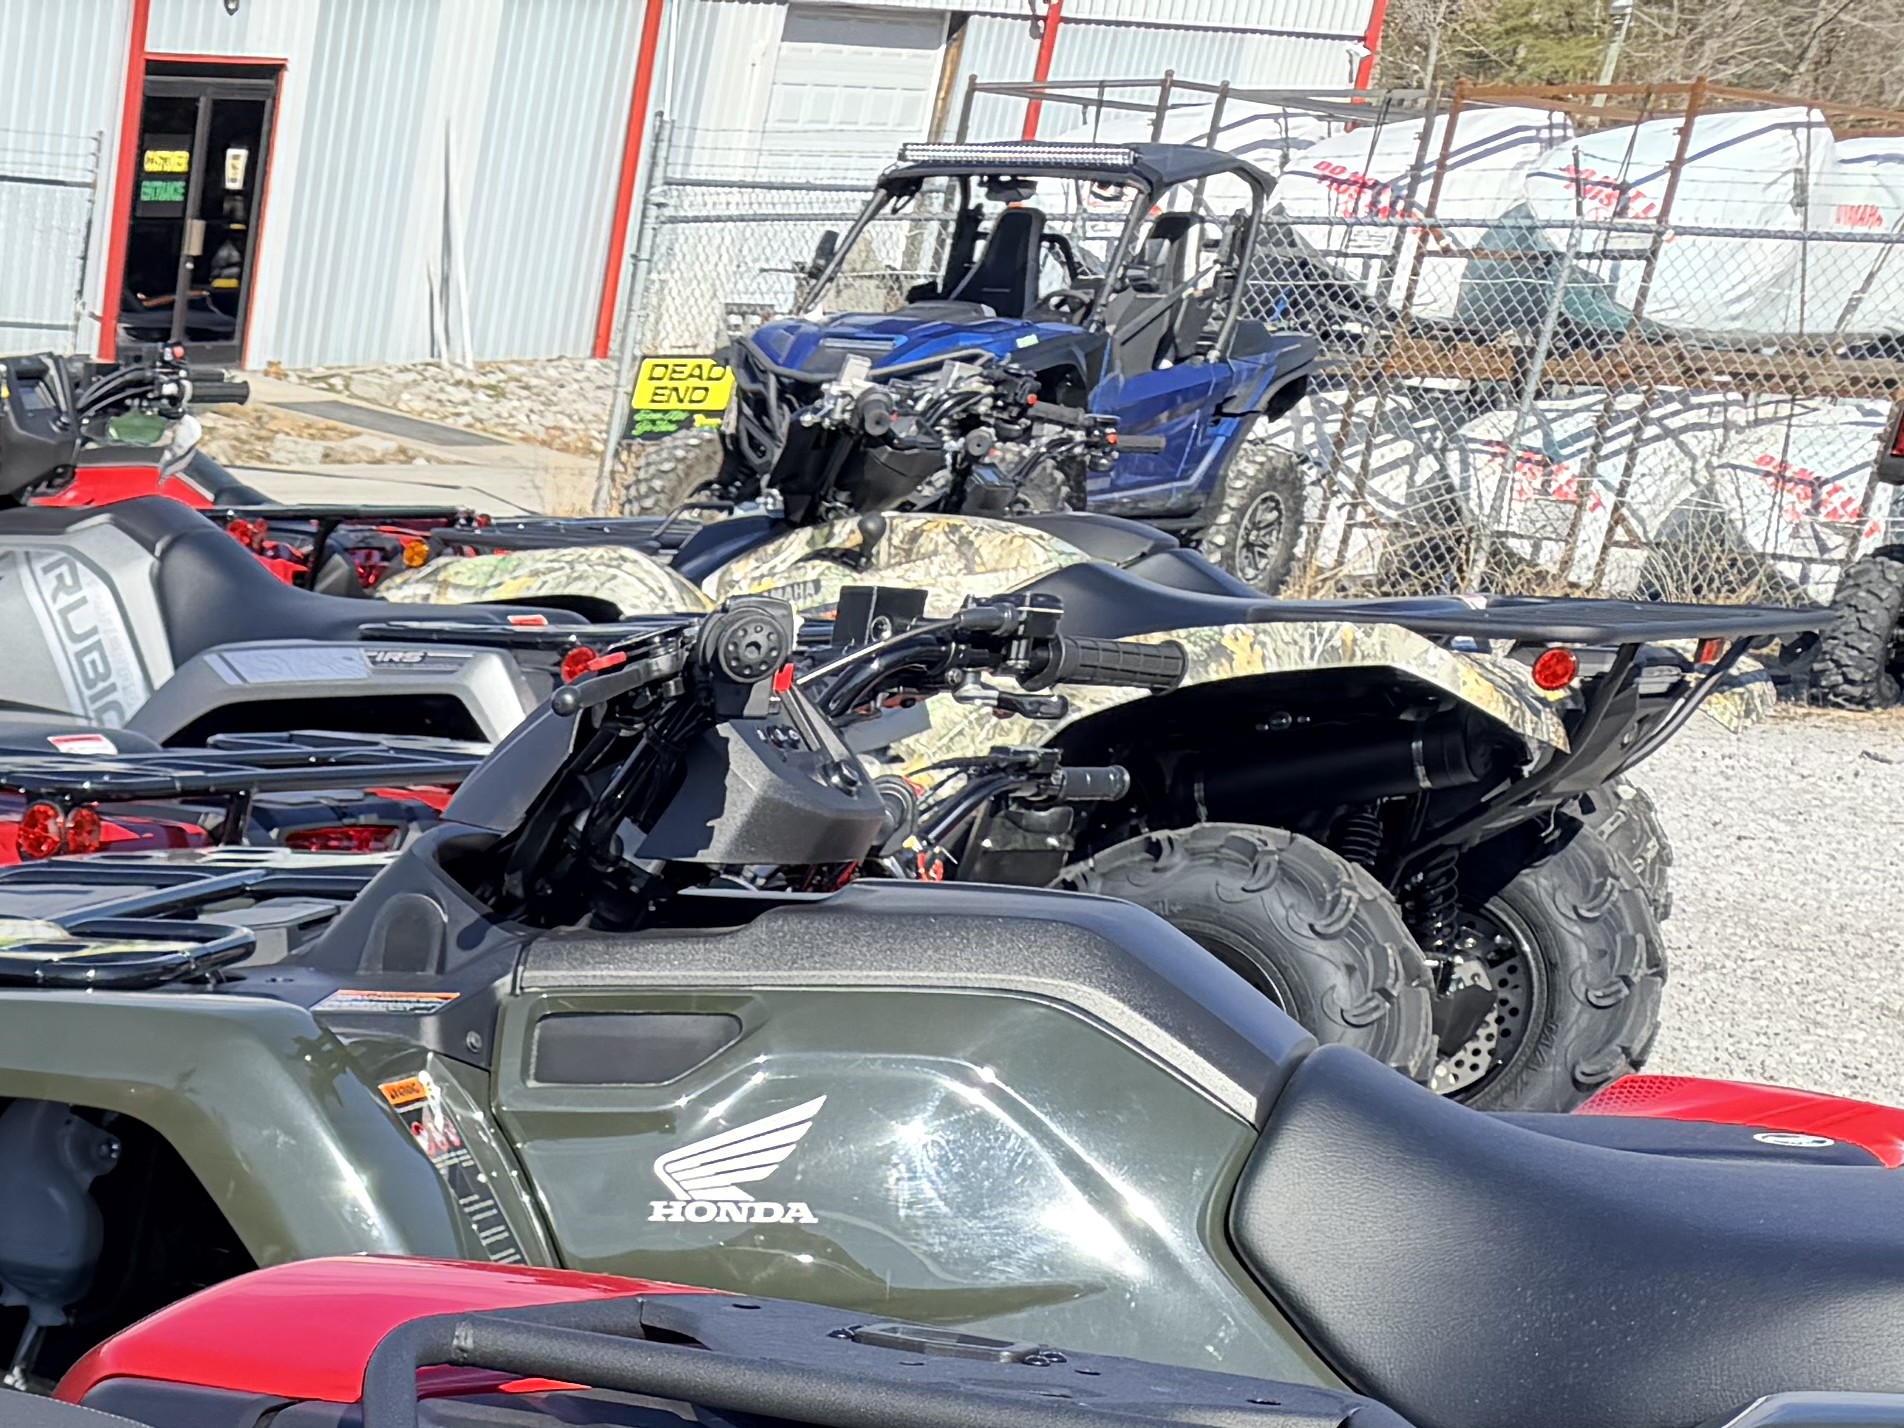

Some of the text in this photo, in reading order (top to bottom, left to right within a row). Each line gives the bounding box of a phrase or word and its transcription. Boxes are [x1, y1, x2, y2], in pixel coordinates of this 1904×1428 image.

[648, 363, 727, 381] DEAD
[649, 386, 710, 404] END
[648, 1201, 818, 1223] HONDA
